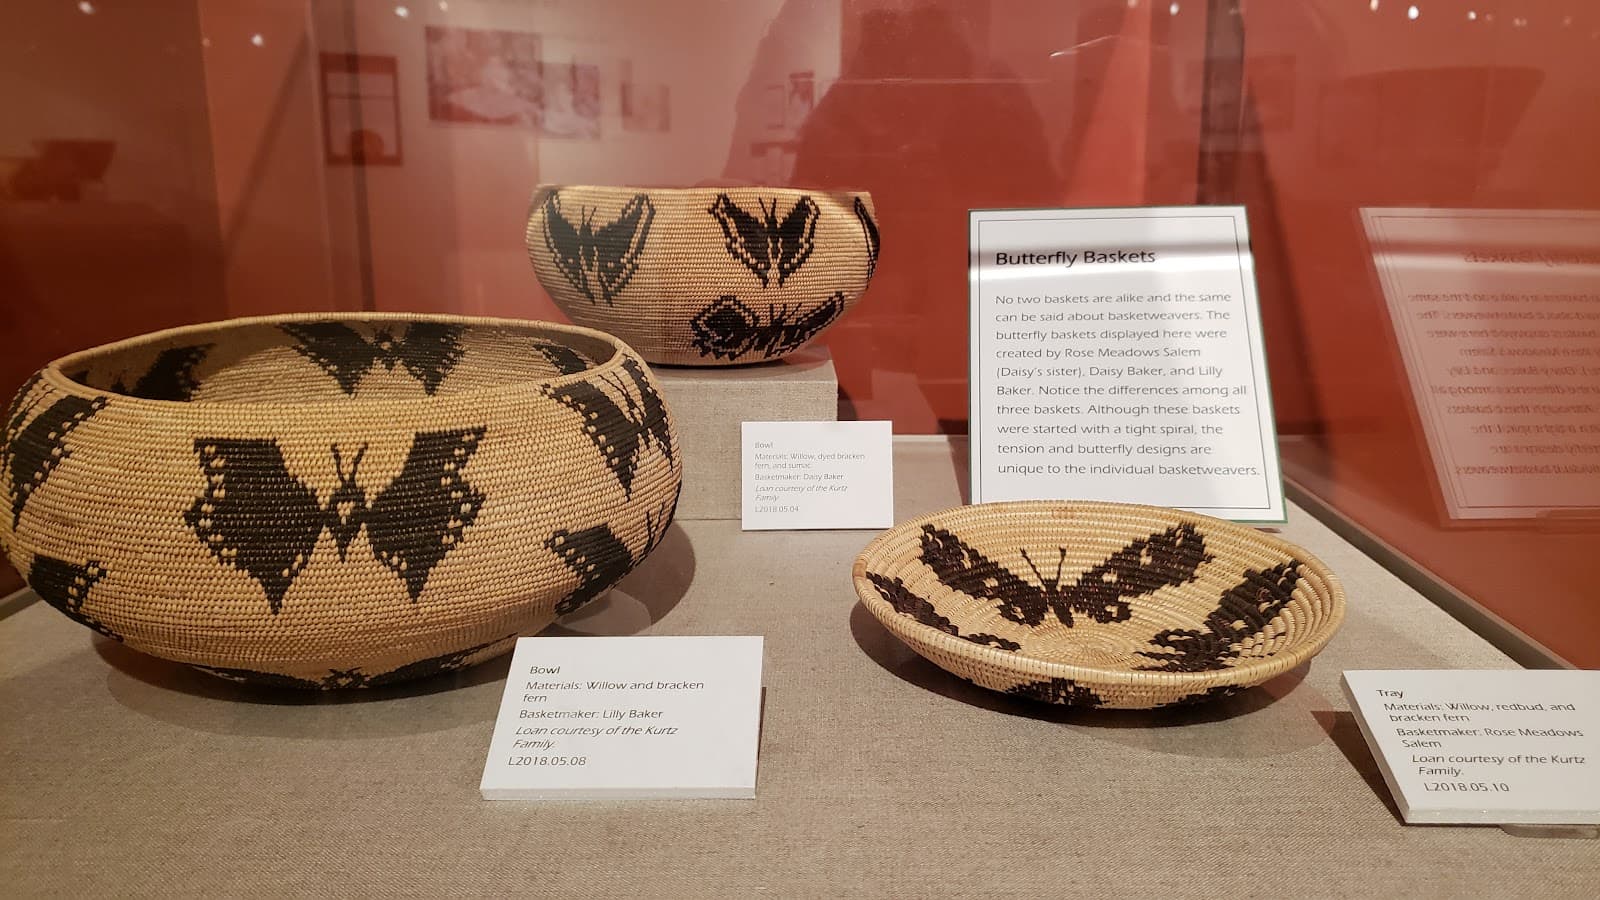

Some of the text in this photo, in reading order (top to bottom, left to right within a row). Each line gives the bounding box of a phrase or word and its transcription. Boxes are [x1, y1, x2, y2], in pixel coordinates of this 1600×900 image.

[996, 250, 1155, 268] Butterfly Baskets
[996, 293, 1231, 304] No two baskets are alike and the same
[996, 310, 1230, 322] can be said about basketweavers. The
[996, 329, 1227, 342] butterfly baskets displayed here were
[996, 348, 1201, 362] created by Rose Meadows Salem
[1089, 366, 1123, 378] Daisy
[1127, 366, 1166, 376] Baker,
[1170, 366, 1194, 375] and
[1198, 365, 1222, 378] Lilly
[997, 385, 1247, 398] Baker. Notice the differences among all
[997, 404, 1240, 416] three baskets. Although these baskets
[997, 424, 1223, 437] were started with a tight spiral, the
[998, 443, 1212, 457] tension and butterfly designs are
[998, 463, 1260, 477] unique to the individual basketweavers.
[529, 665, 561, 674] Bowl
[525, 681, 704, 690] Materials: Willow and bracken
[523, 693, 547, 702] fern
[1376, 689, 1404, 698] Tray
[1384, 703, 1576, 712] Materials: Willow, redbud, and
[519, 709, 663, 720] Basketmaker: Lilly Baker
[1389, 714, 1470, 722] bracken fern
[515, 725, 678, 737] Loan courtesy of the Kurtz
[1396, 727, 1584, 736] Basketmaker: Rose Meadows
[512, 739, 556, 751] Family.
[1402, 739, 1442, 747] Salem
[508, 756, 587, 765] L2018.05.08
[1412, 754, 1586, 765] Loan courtesy of the Kurtz
[1418, 766, 1465, 777] Family.
[1424, 782, 1510, 791] L2018.05.10
